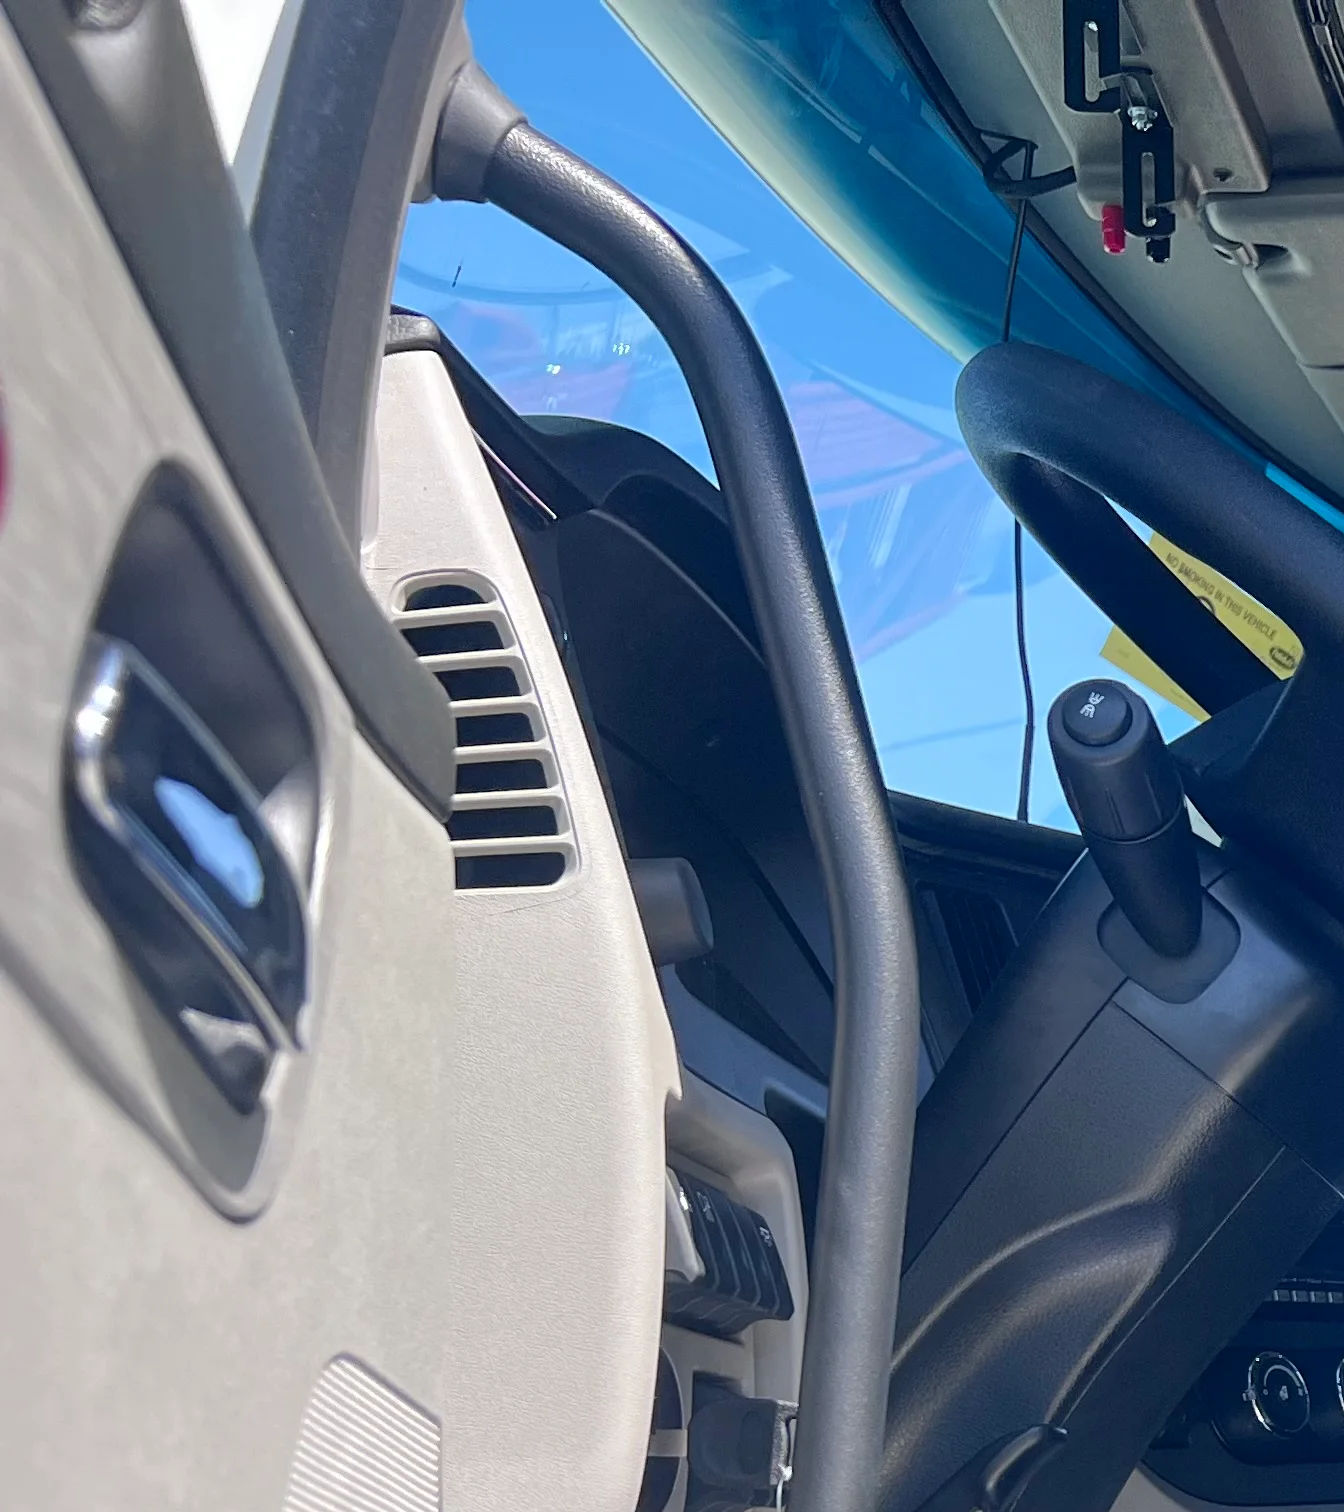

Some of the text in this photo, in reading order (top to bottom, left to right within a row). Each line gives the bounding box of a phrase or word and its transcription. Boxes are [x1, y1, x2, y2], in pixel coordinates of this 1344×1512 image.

[1165, 552, 1278, 641] NO SMOKING IN THIS VEHICLE
